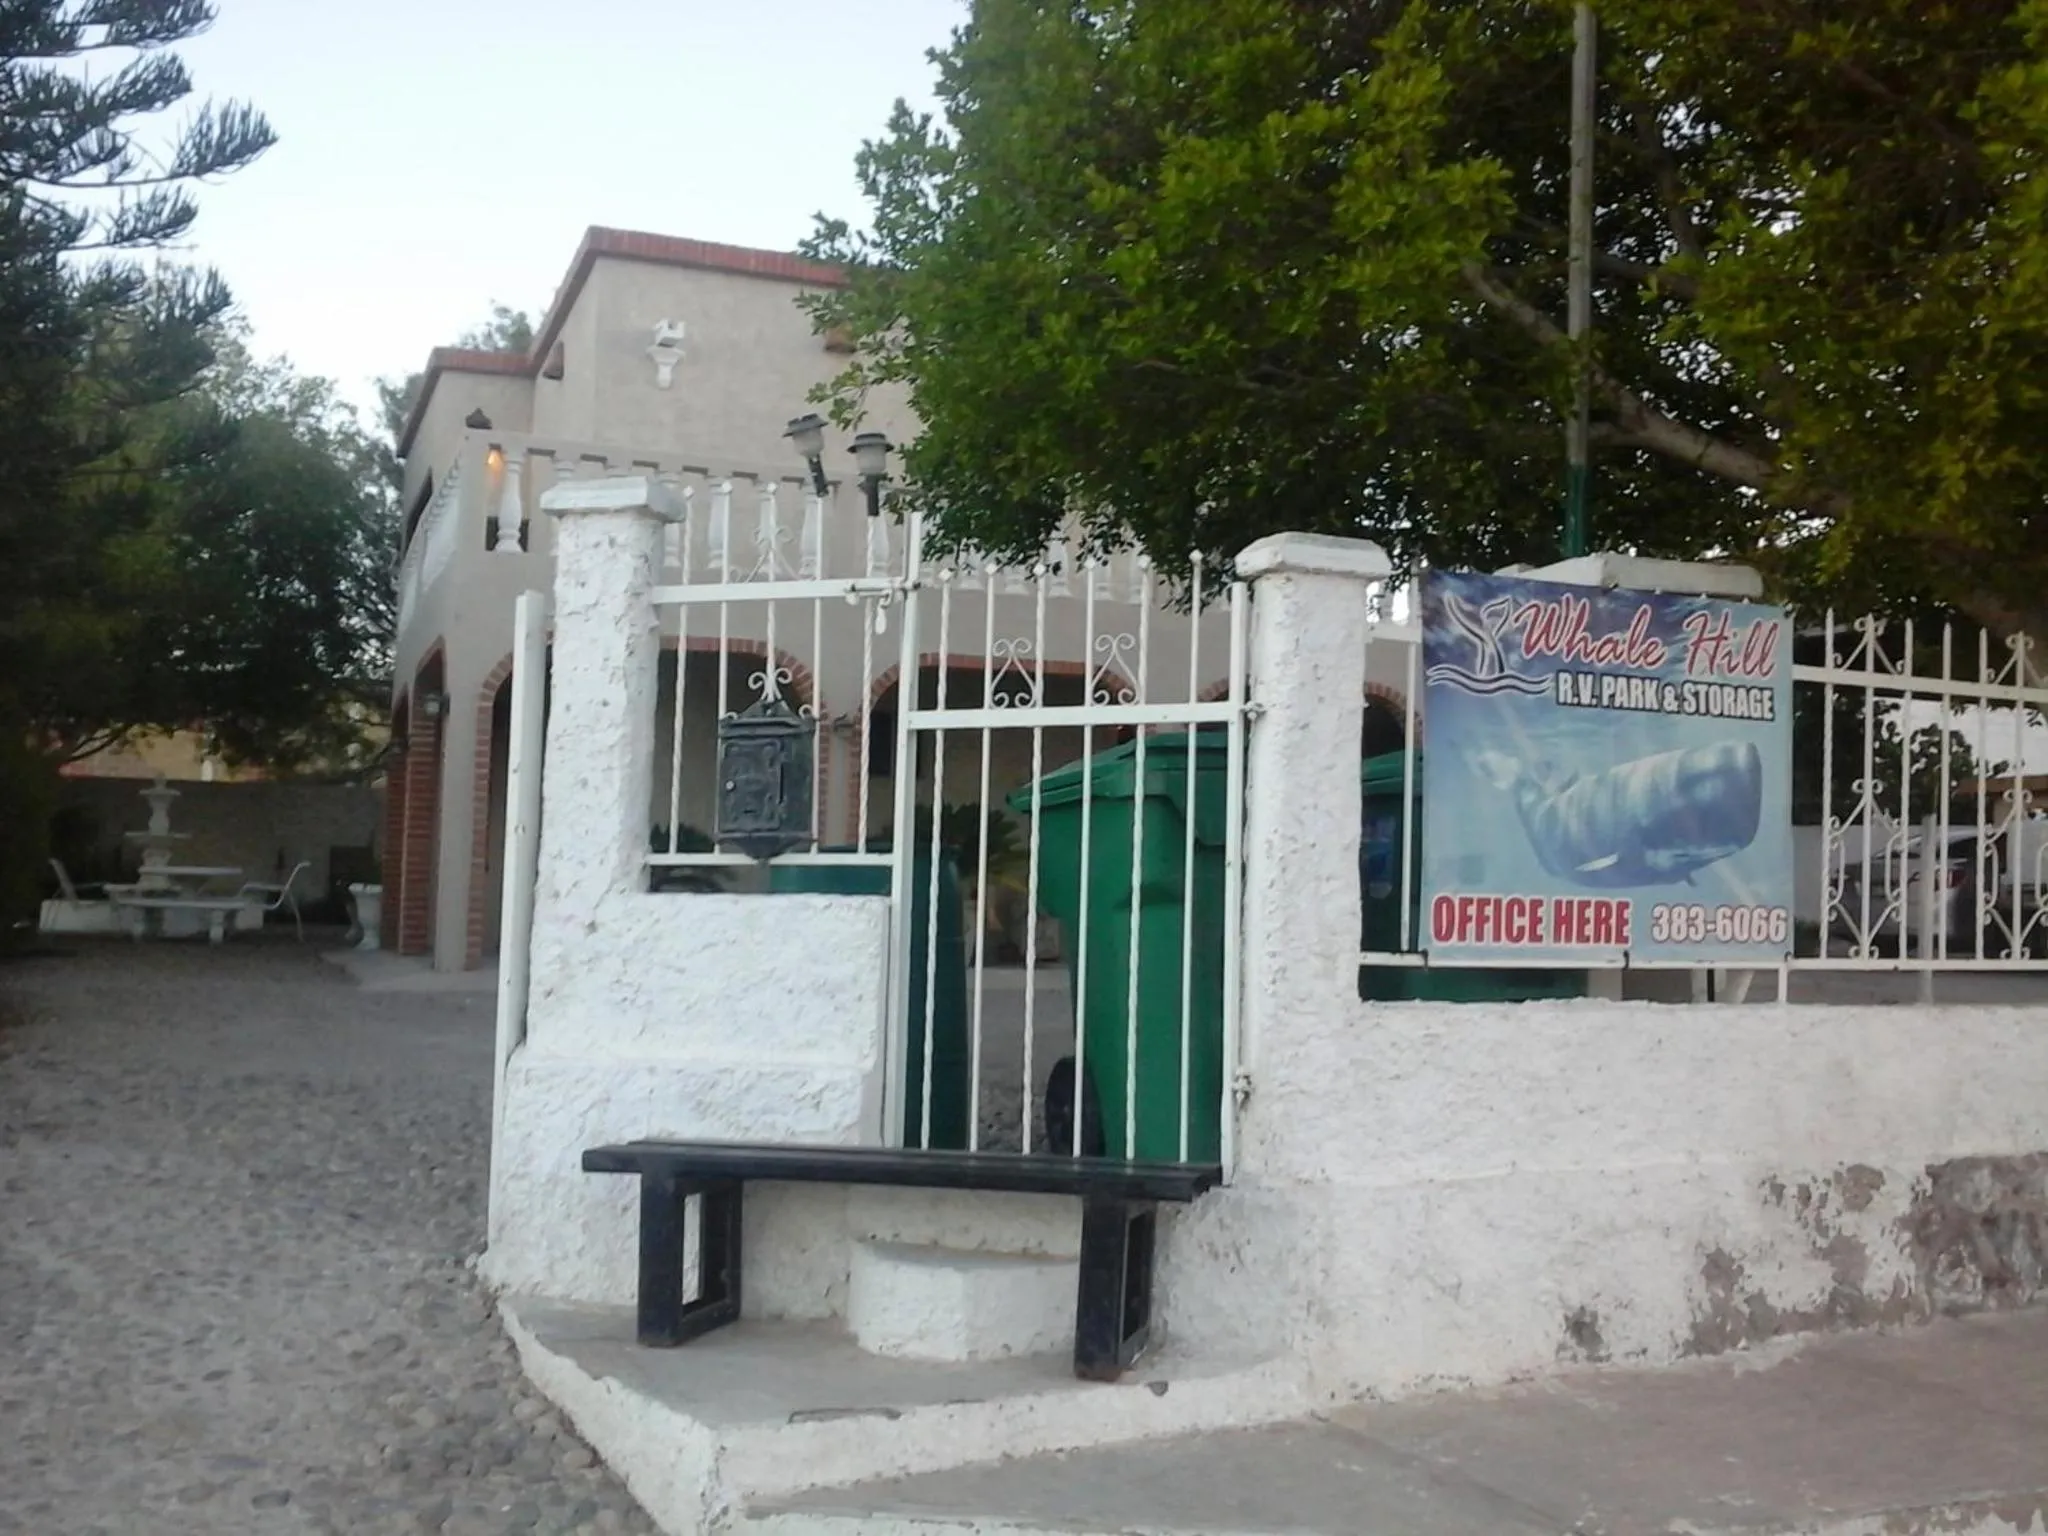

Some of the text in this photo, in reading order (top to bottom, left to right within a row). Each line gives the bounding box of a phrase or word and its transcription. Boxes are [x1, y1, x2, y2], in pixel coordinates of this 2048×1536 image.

[1513, 593, 1780, 677] Whale Hill
[1557, 672, 1774, 720] R.V. PARK & STORAGE
[1433, 895, 1632, 945] OFFICE HERE
[1651, 903, 1788, 943] 383-6066
